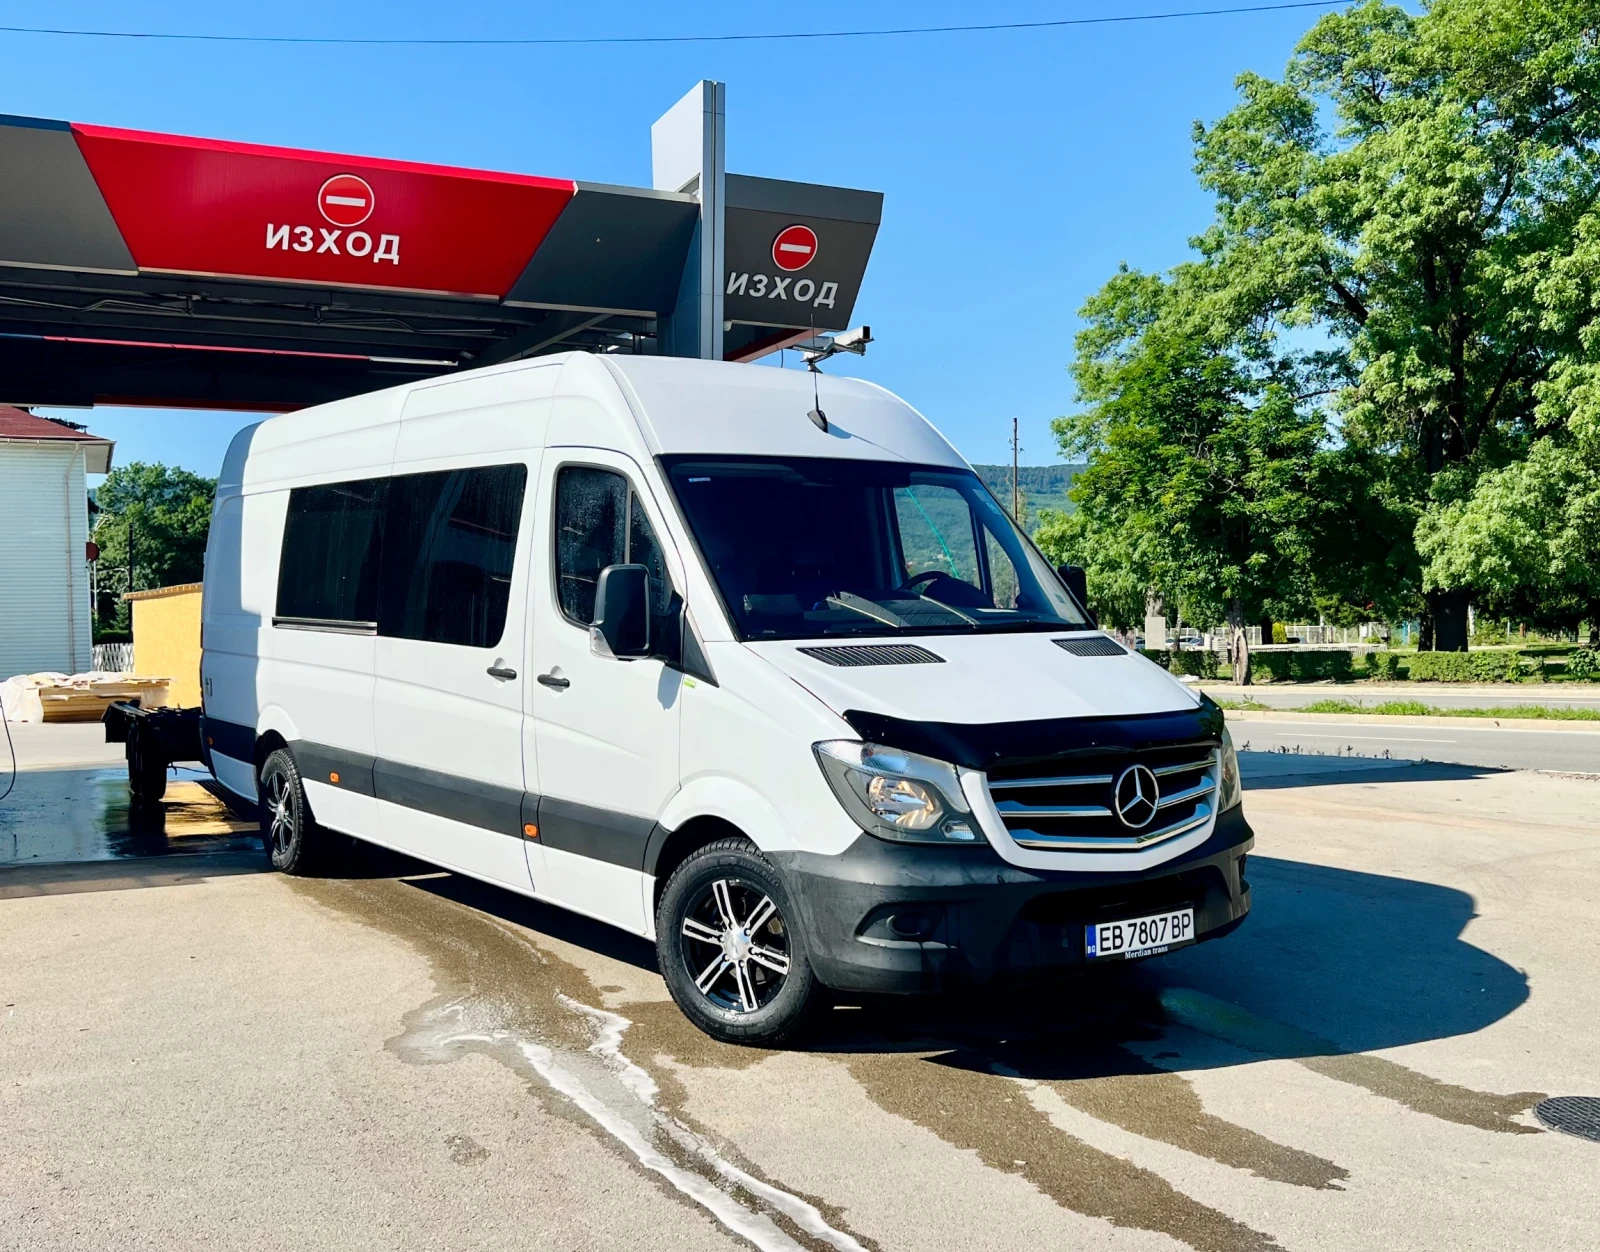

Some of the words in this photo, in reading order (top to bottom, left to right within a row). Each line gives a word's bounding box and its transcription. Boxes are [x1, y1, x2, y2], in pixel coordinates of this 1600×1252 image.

[265, 223, 400, 265] ИЗХОД
[726, 271, 839, 309] ИЗХОД
[1087, 945, 1096, 953] BG
[1100, 925, 1124, 952] EB
[1127, 917, 1168, 948] 7807
[1171, 913, 1191, 939] BP
[1152, 945, 1168, 954] trans
